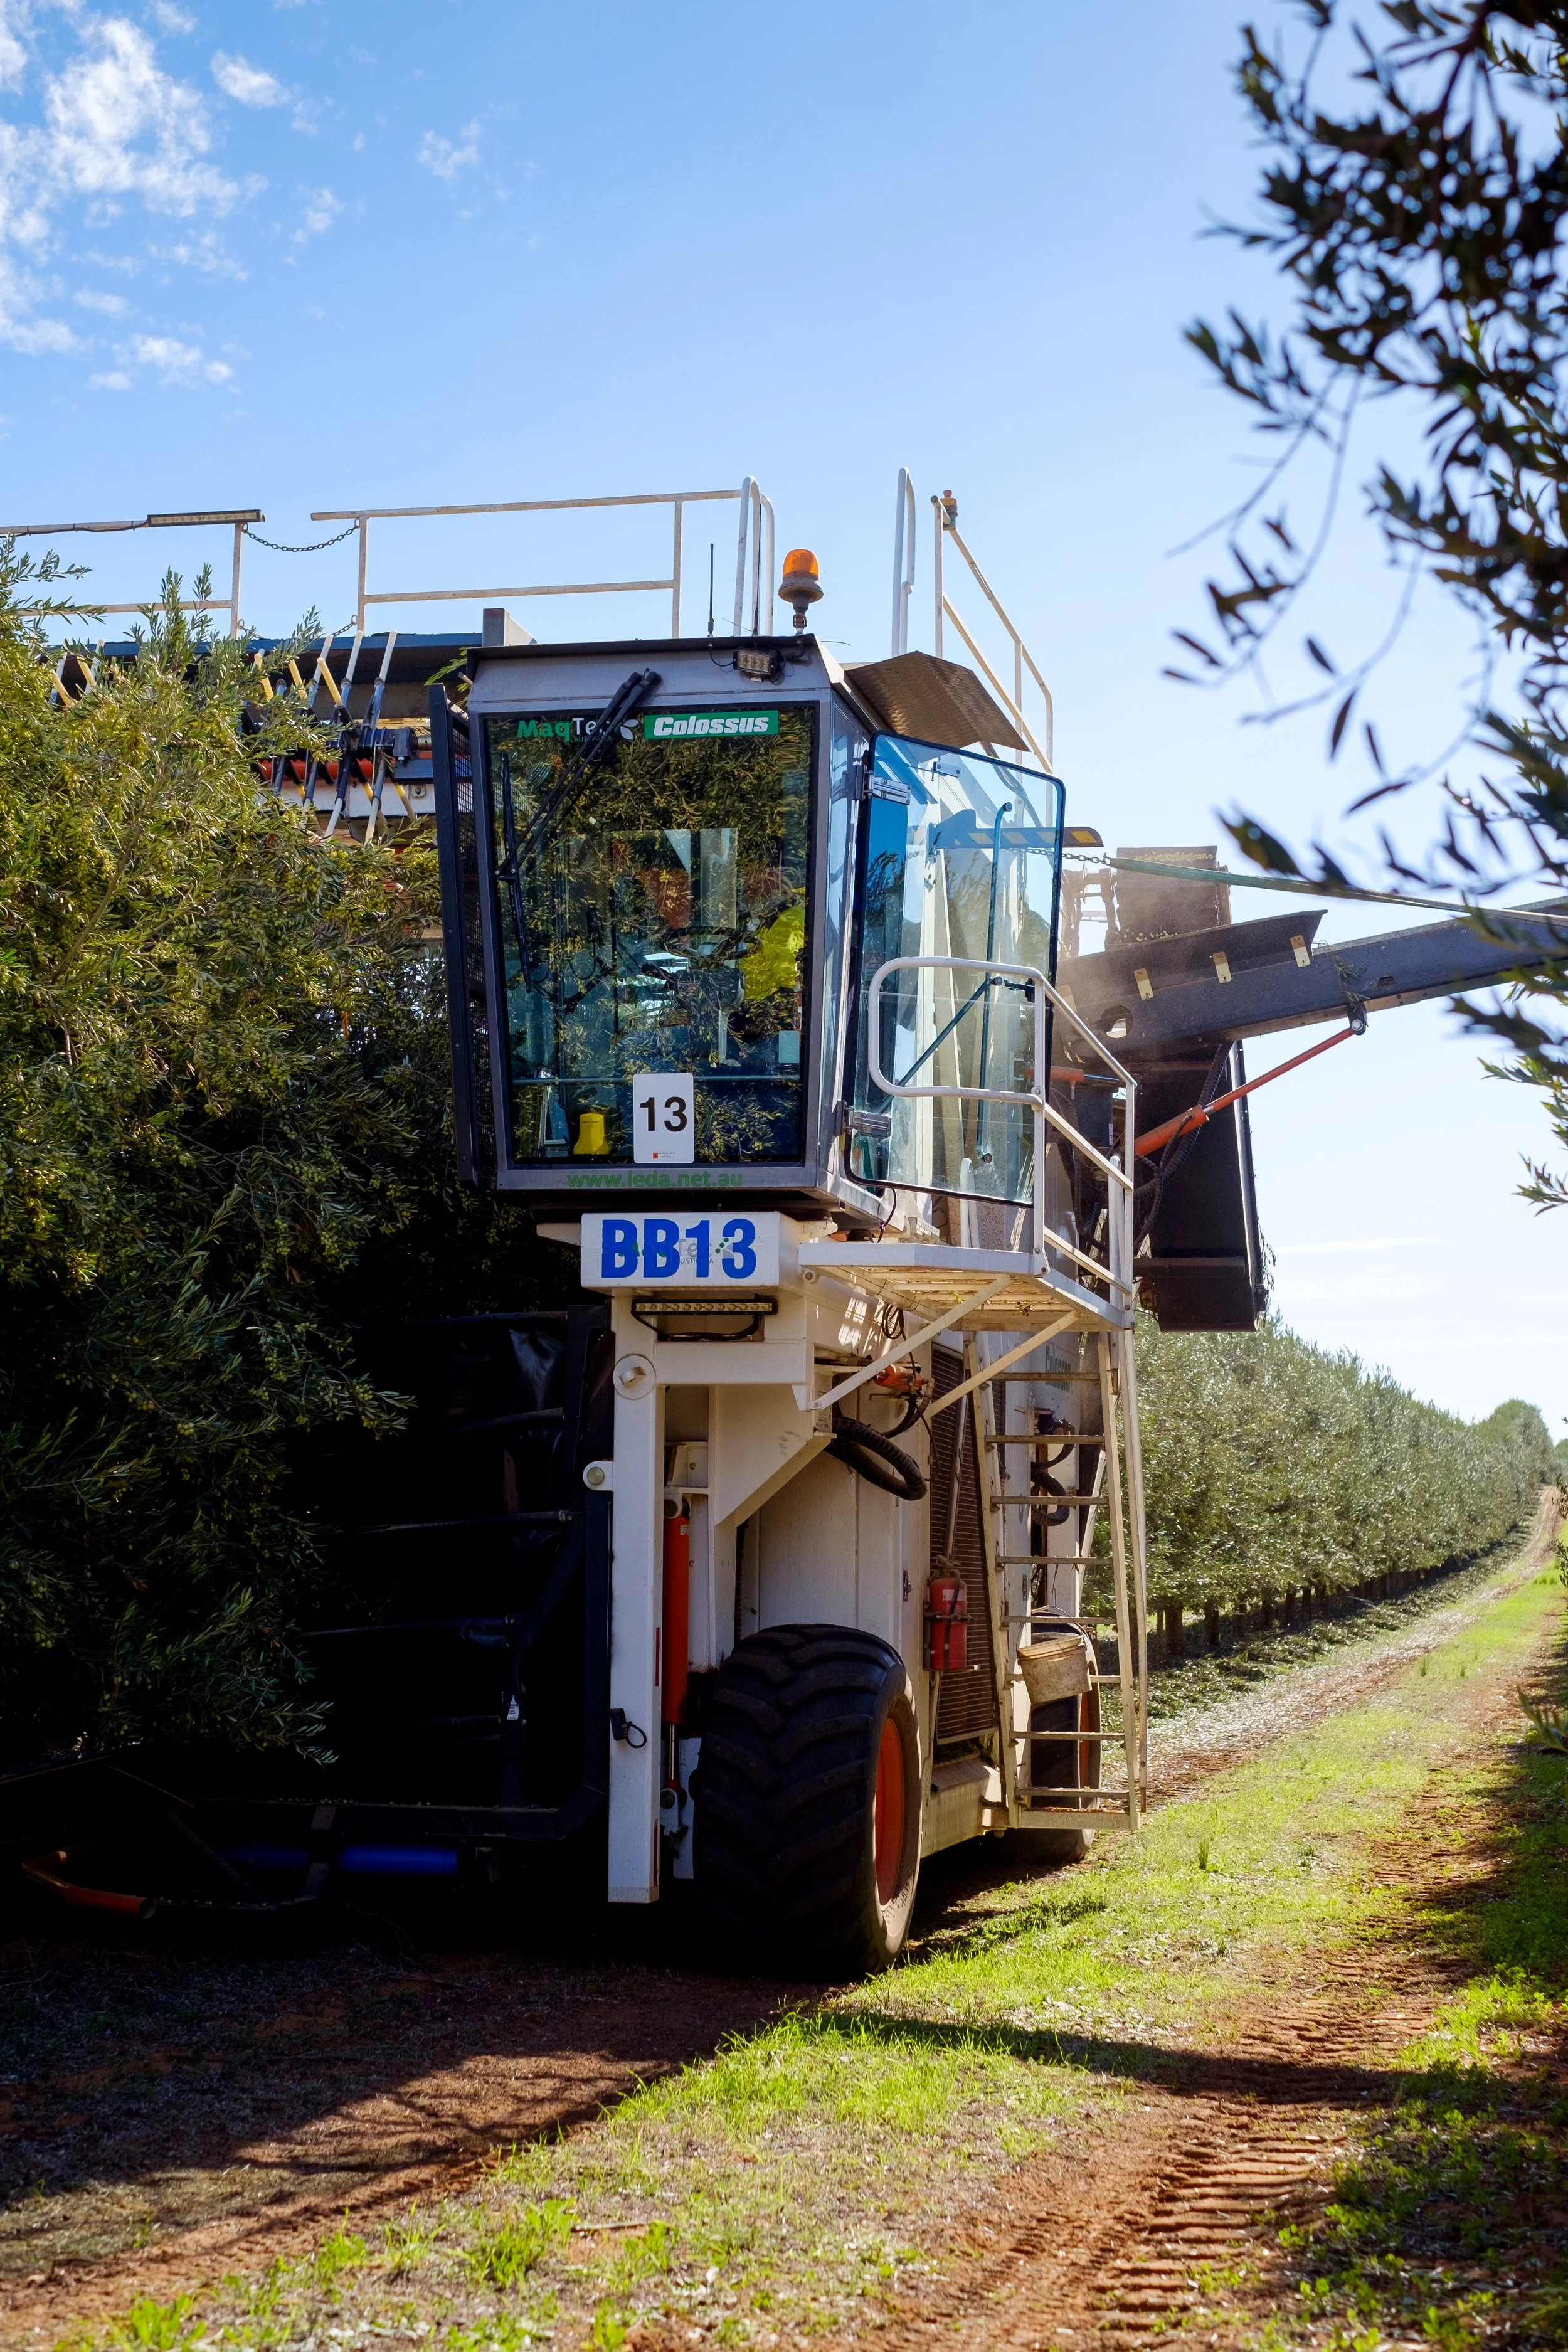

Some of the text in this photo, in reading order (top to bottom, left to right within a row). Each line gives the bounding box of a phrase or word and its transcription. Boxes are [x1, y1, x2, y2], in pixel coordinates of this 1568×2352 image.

[517, 717, 608, 742] MaqTe
[653, 716, 769, 736] Colossus
[640, 1096, 687, 1132] 13
[566, 1169, 743, 1187] www.leda.net.au
[601, 1219, 757, 1279] BB13
